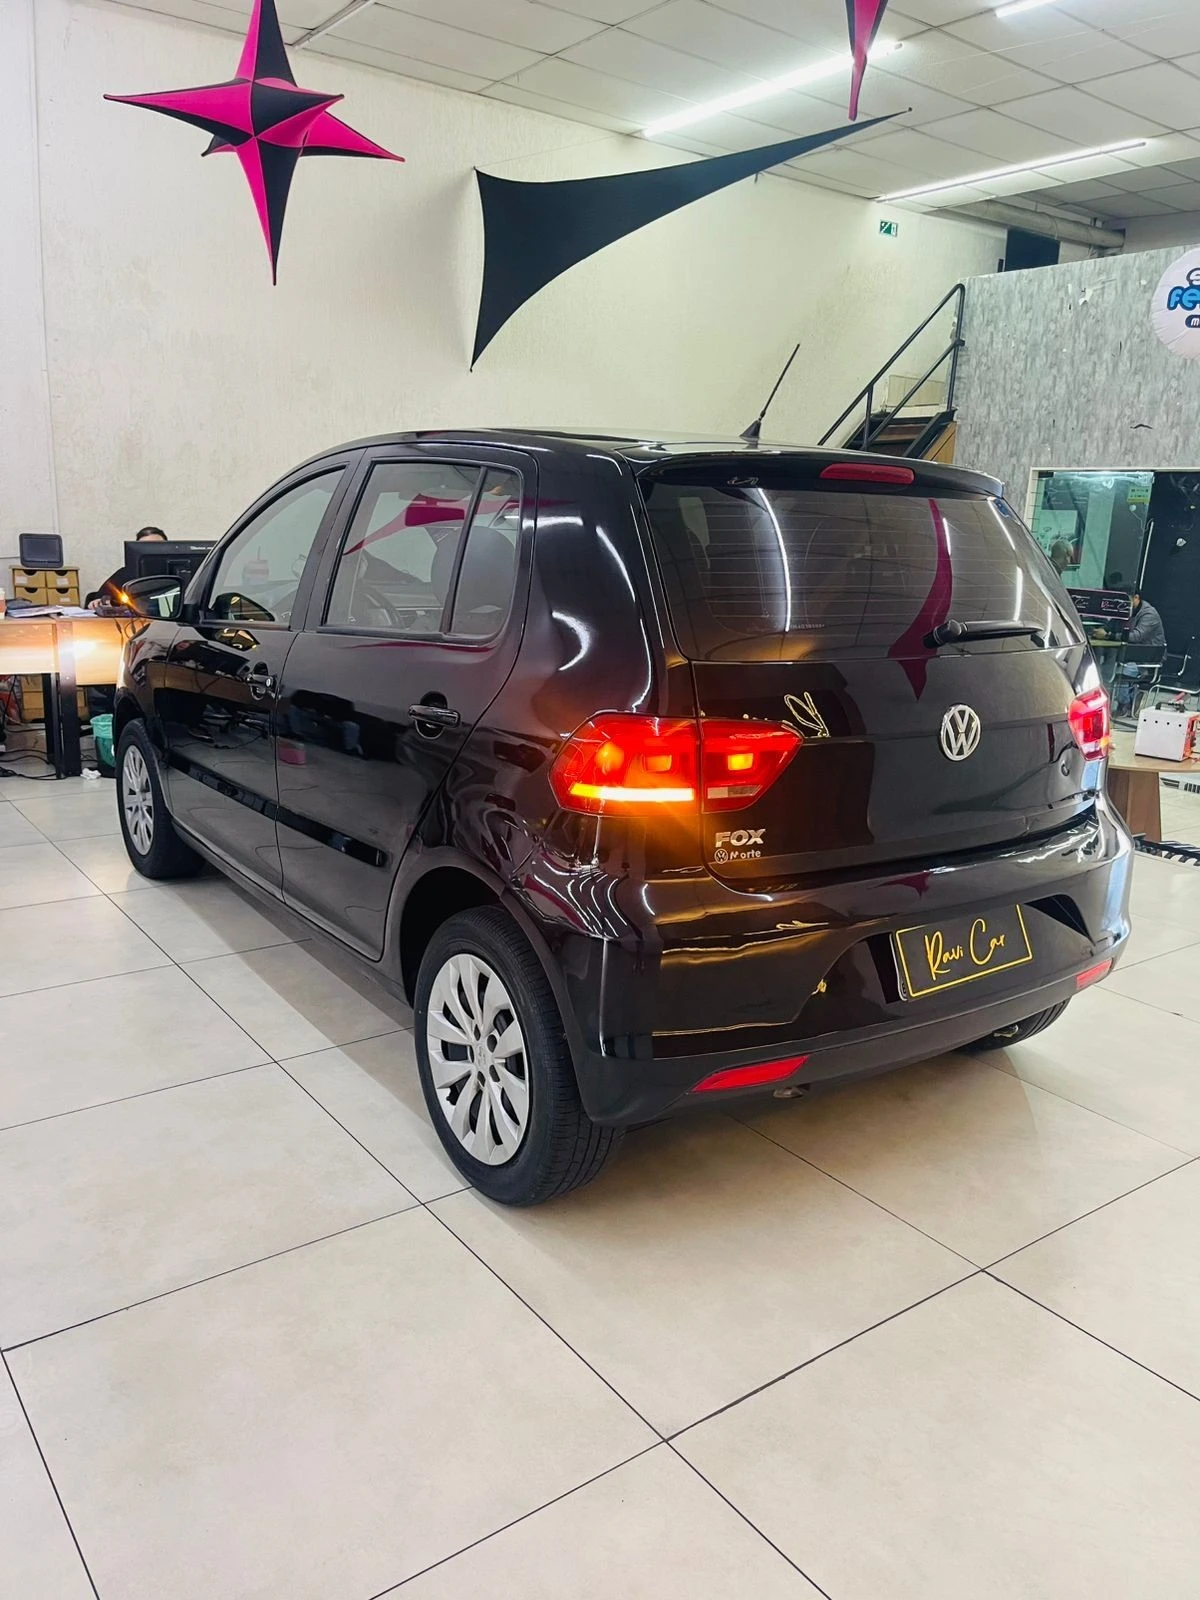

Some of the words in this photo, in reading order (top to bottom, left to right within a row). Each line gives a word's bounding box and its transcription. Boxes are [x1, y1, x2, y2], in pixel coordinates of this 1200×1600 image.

[715, 828, 766, 848] FOX
[924, 931, 964, 981] Ravi
[969, 918, 1005, 965] Car
